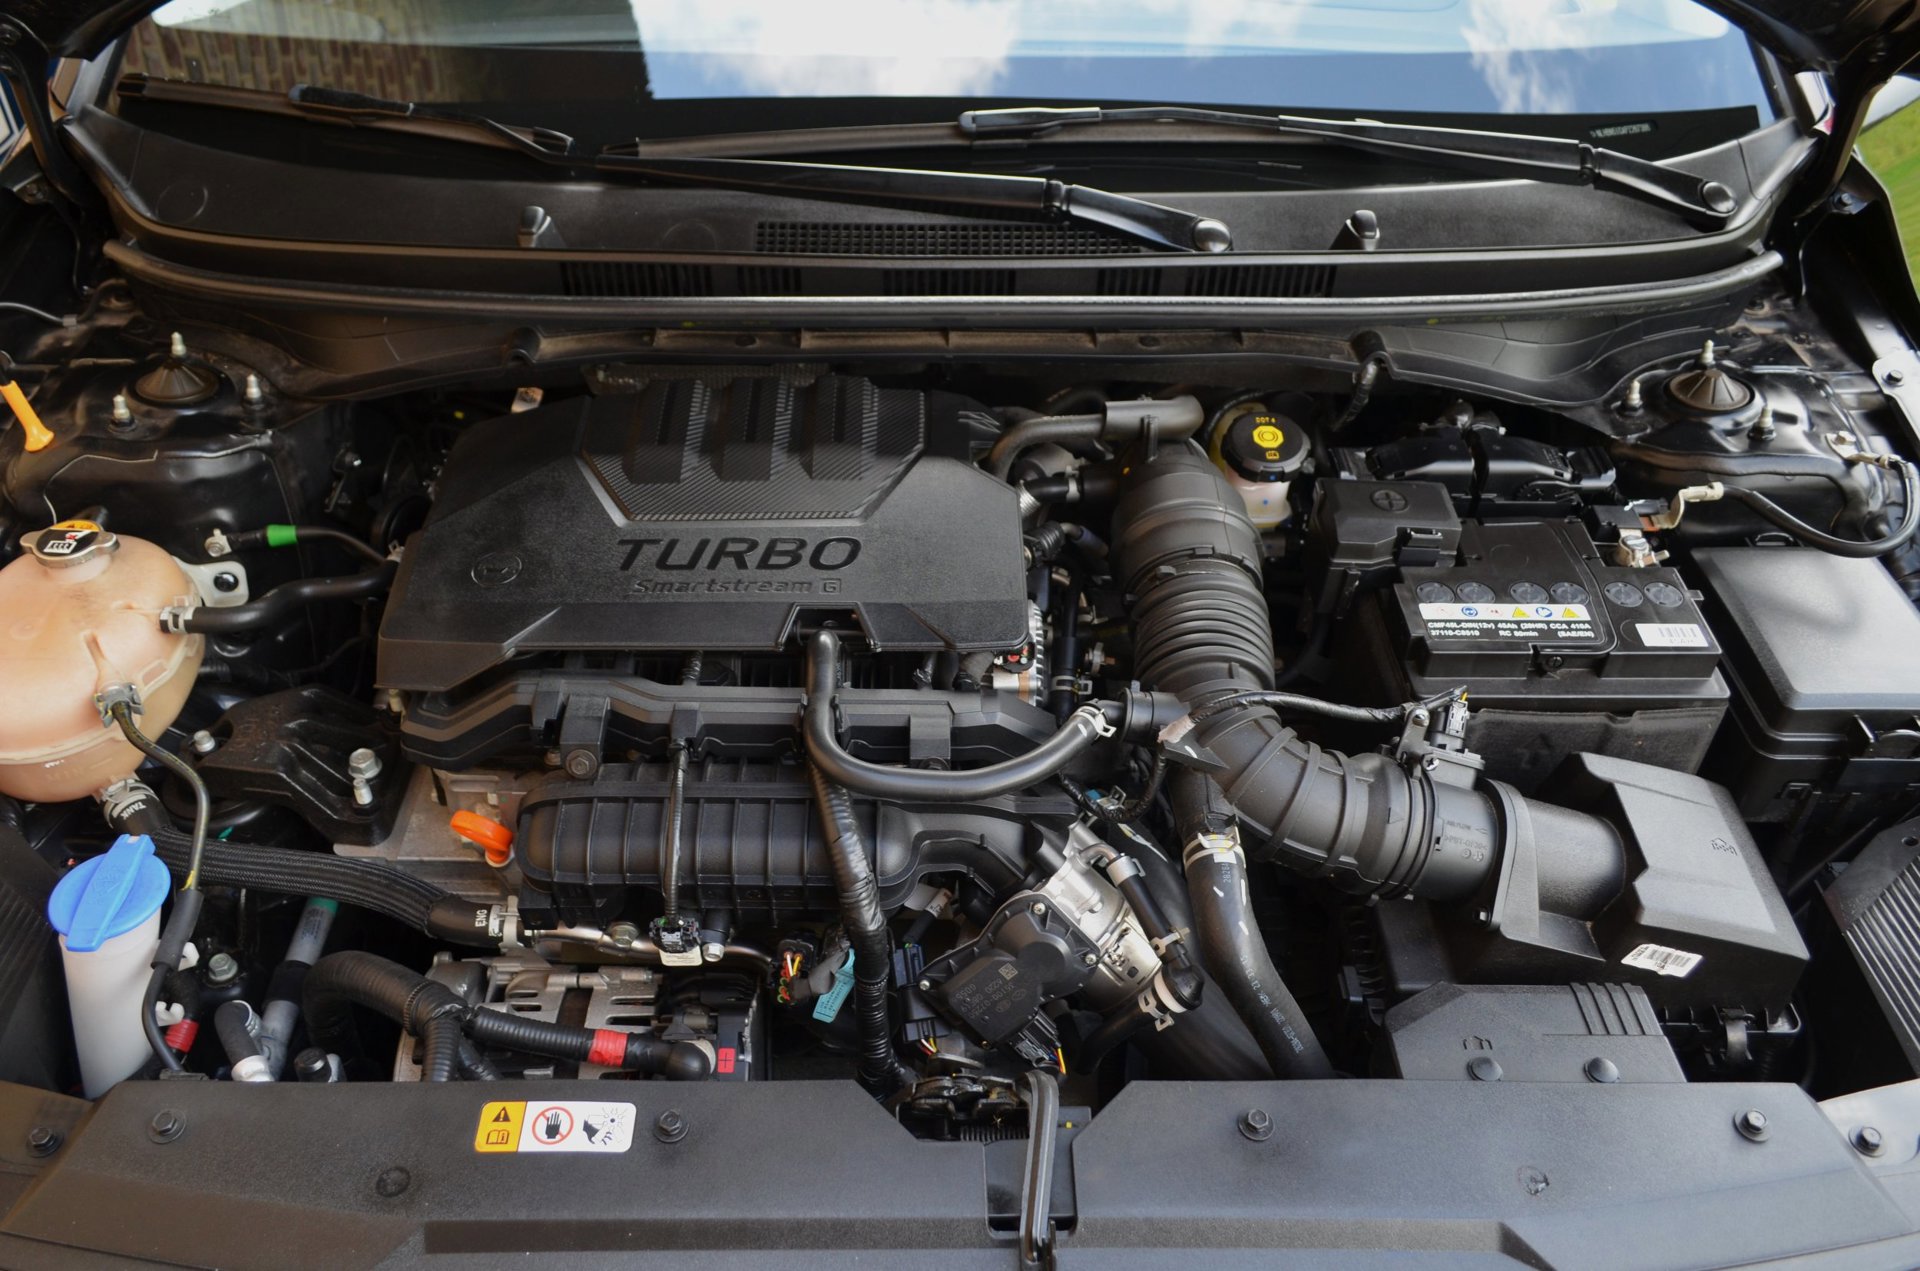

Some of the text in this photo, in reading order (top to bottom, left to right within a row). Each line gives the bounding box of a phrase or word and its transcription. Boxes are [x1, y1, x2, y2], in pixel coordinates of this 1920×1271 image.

[617, 537, 862, 571] TURBO
[632, 578, 813, 595] Smartstream
[1549, 622, 1569, 630] CCA
[120, 801, 147, 820] TANK
[475, 909, 488, 927] ENG
